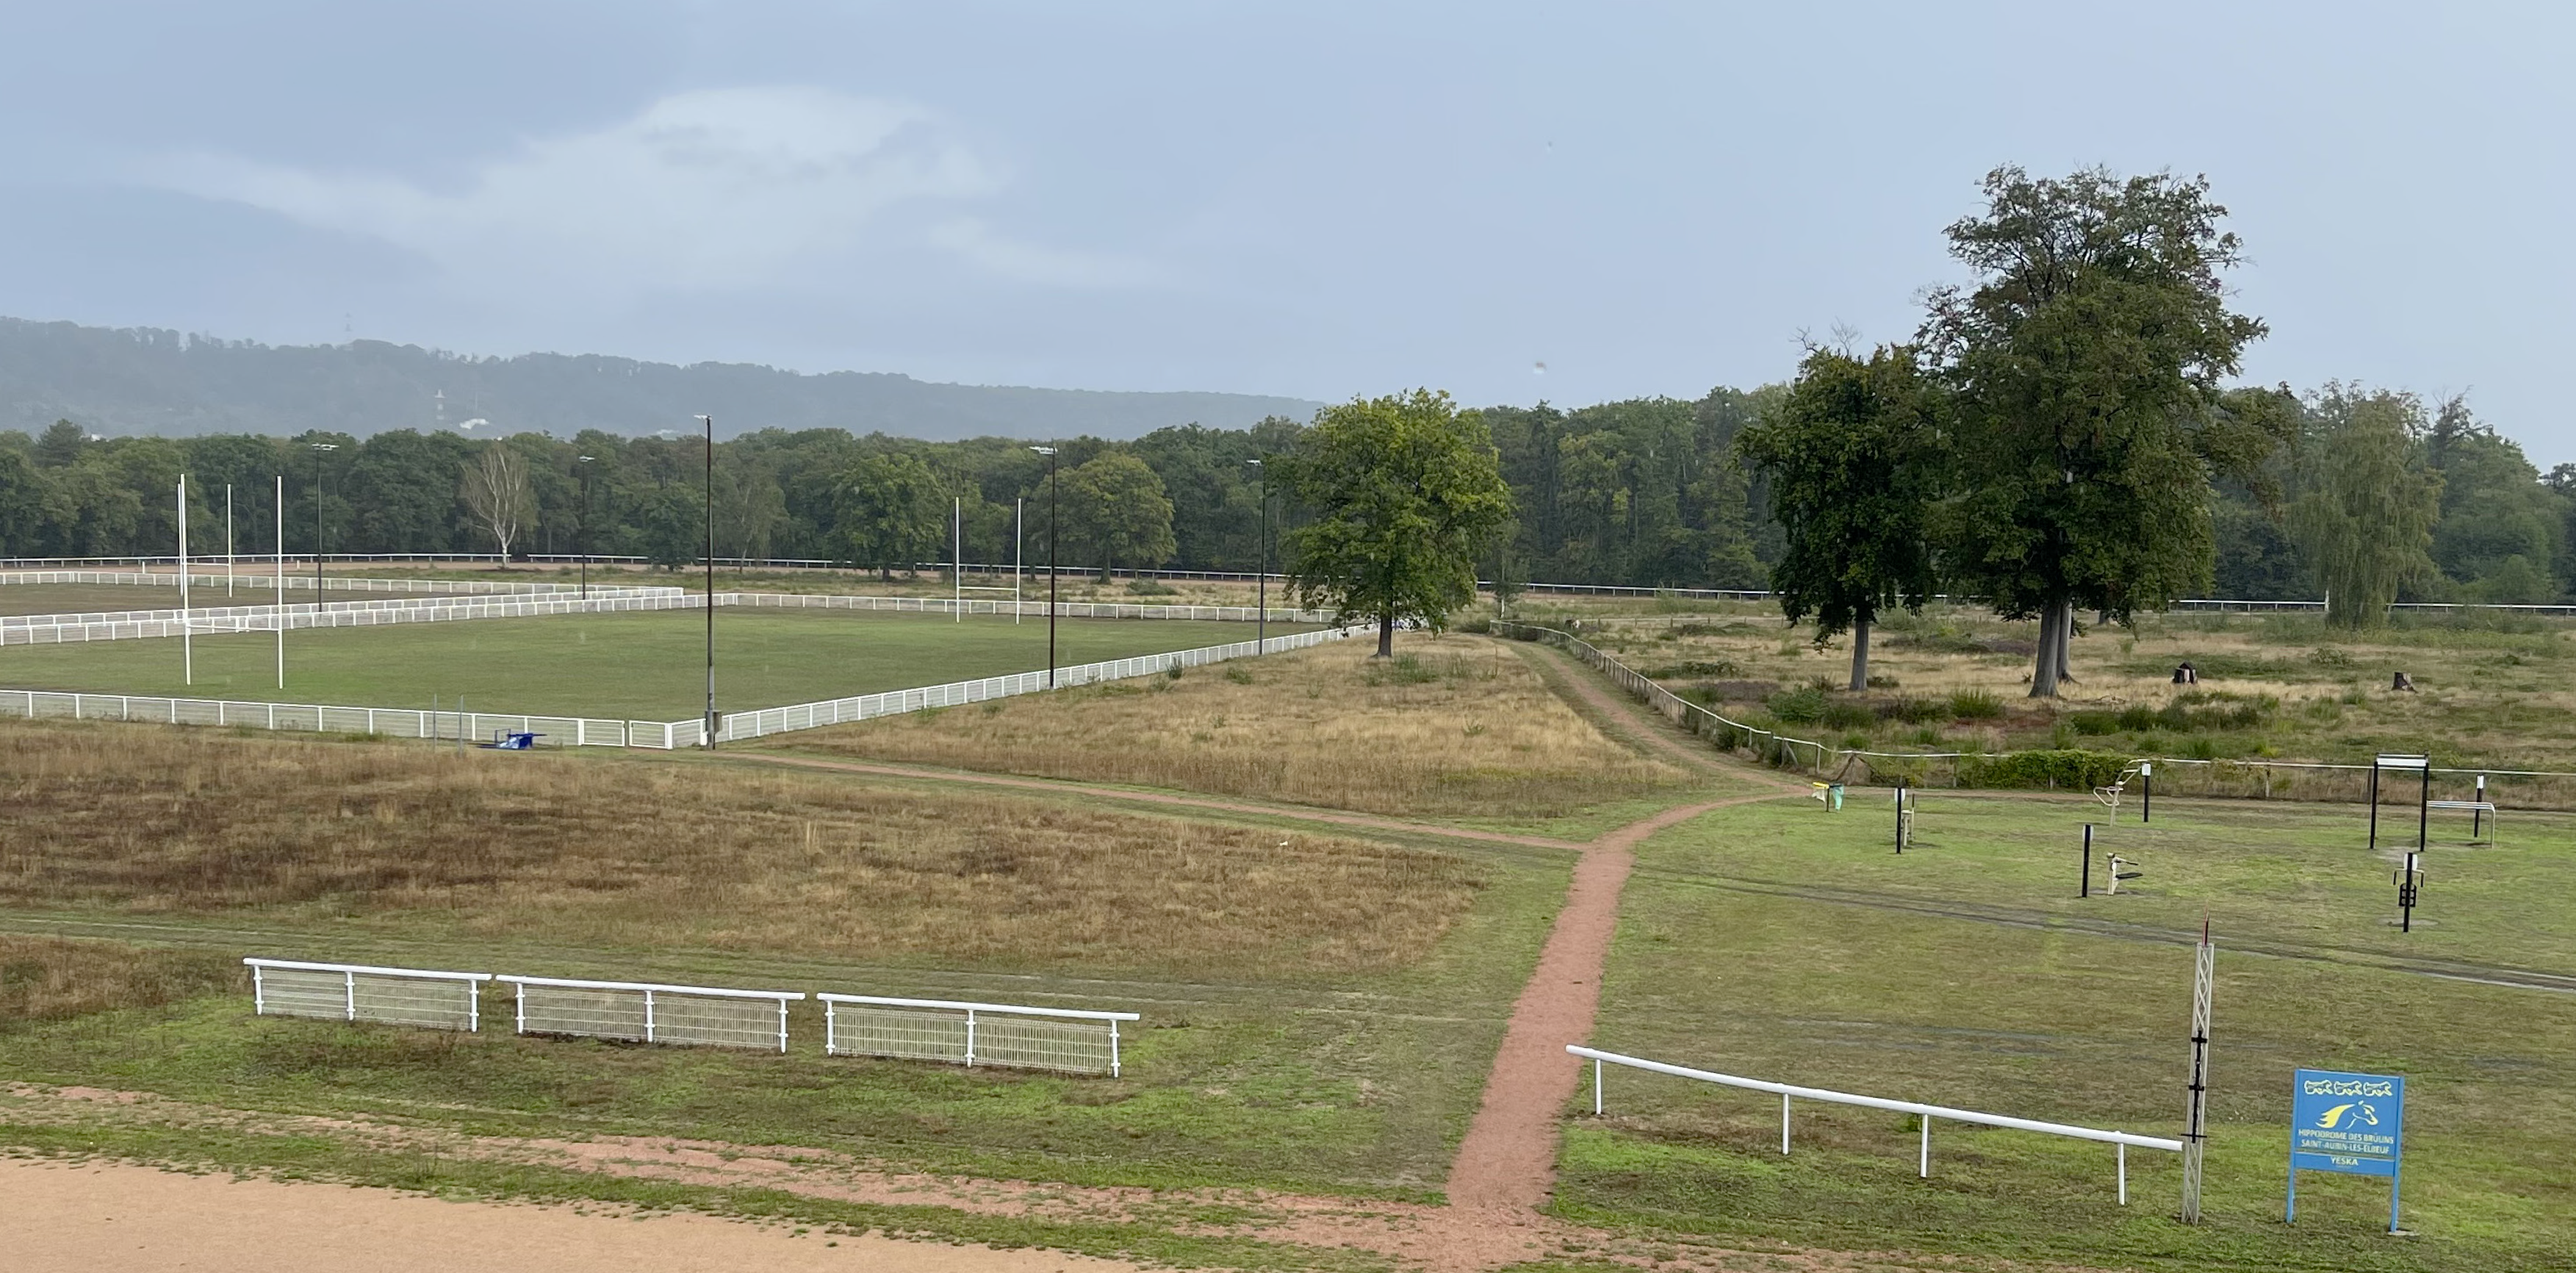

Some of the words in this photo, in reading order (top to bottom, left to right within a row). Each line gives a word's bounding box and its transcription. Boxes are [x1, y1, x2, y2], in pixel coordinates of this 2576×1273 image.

[2298, 1128, 2347, 1140] HIPPODROME
[2348, 1133, 2362, 1141] DES
[2331, 1156, 2359, 1166] YESKA
